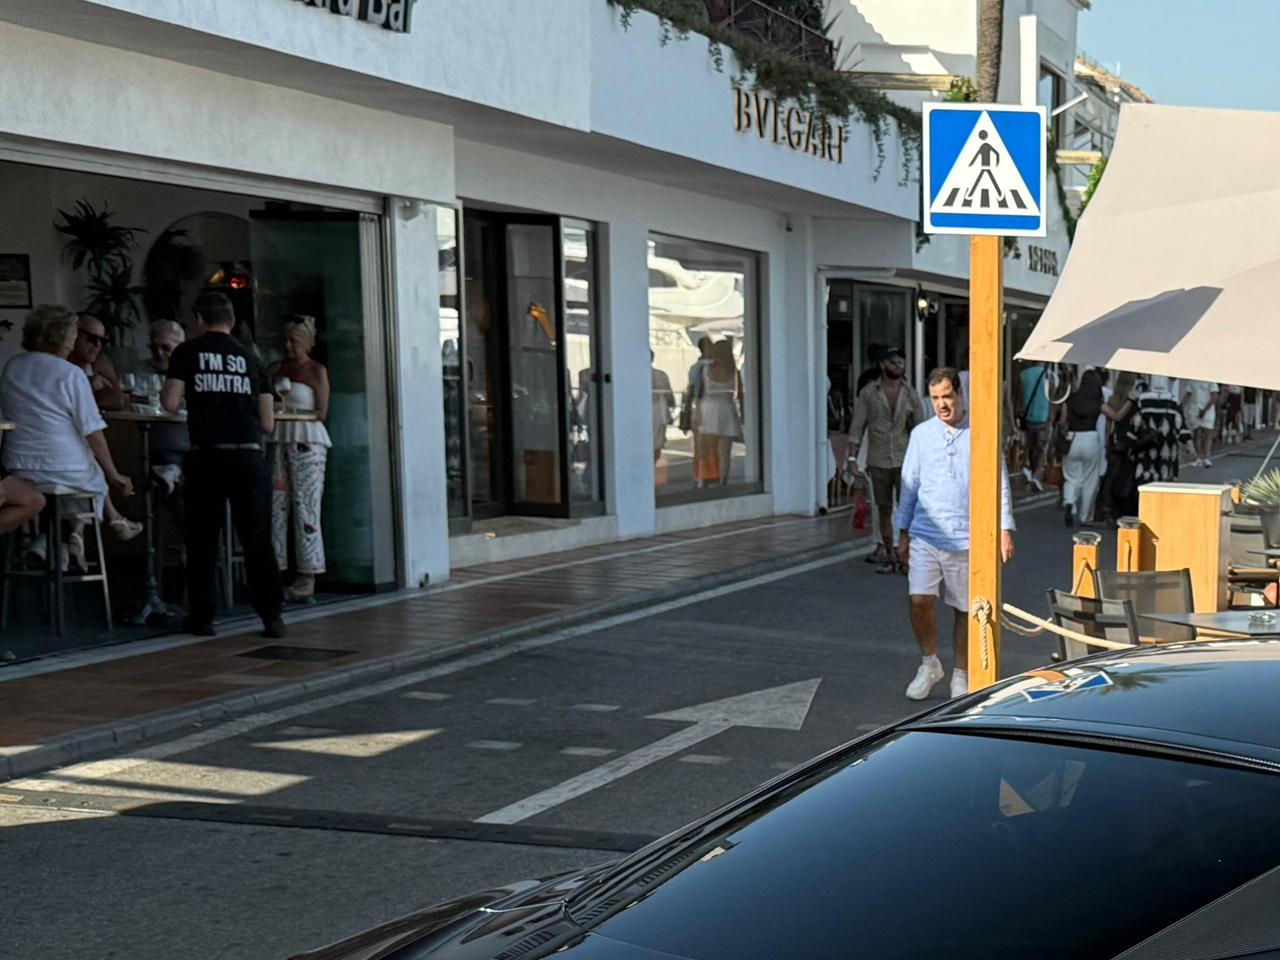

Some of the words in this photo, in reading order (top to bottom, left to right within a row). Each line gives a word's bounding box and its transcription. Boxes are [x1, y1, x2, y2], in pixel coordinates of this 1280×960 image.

[733, 87, 843, 164] BVLGARI
[199, 352, 224, 371] I'M
[226, 354, 248, 374] SO
[194, 373, 252, 395] SINATRA
